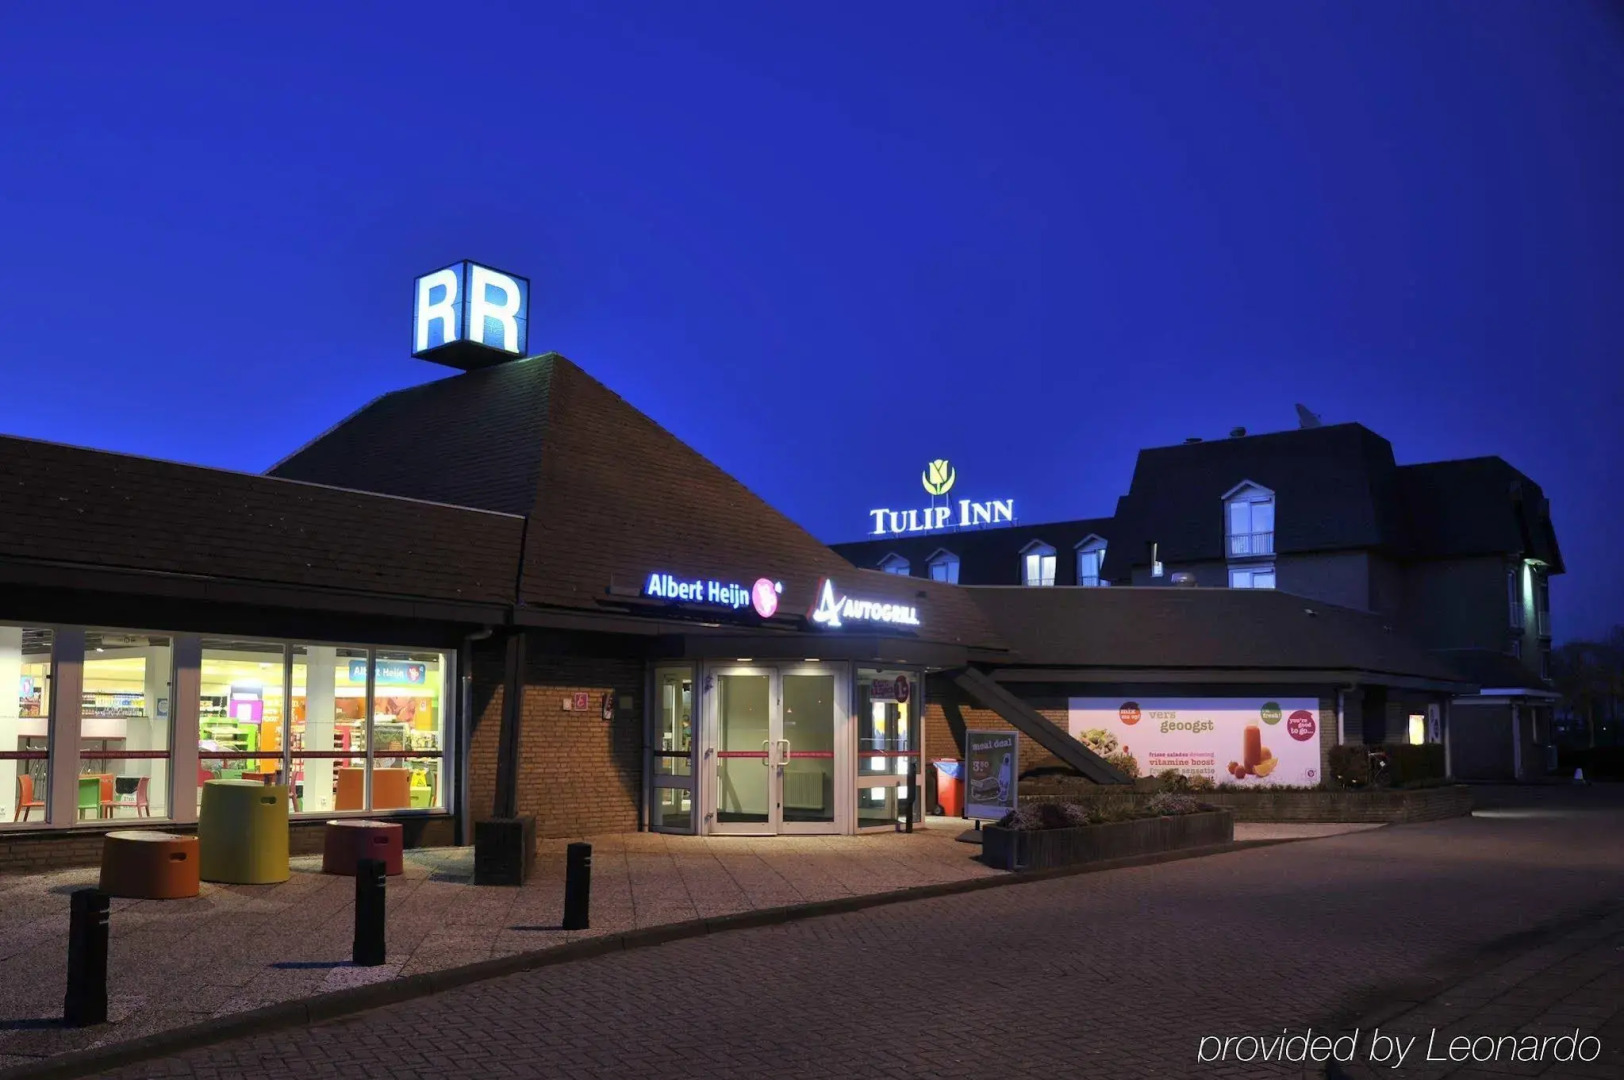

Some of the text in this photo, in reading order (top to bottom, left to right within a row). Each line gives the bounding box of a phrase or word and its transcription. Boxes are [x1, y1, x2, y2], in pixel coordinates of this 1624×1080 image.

[416, 269, 458, 352] R
[469, 264, 521, 354] R
[870, 499, 1014, 535] TULIP INN
[647, 573, 751, 609] Albert Heijn
[1149, 711, 1176, 719] vers
[1160, 719, 1214, 734] geoogst
